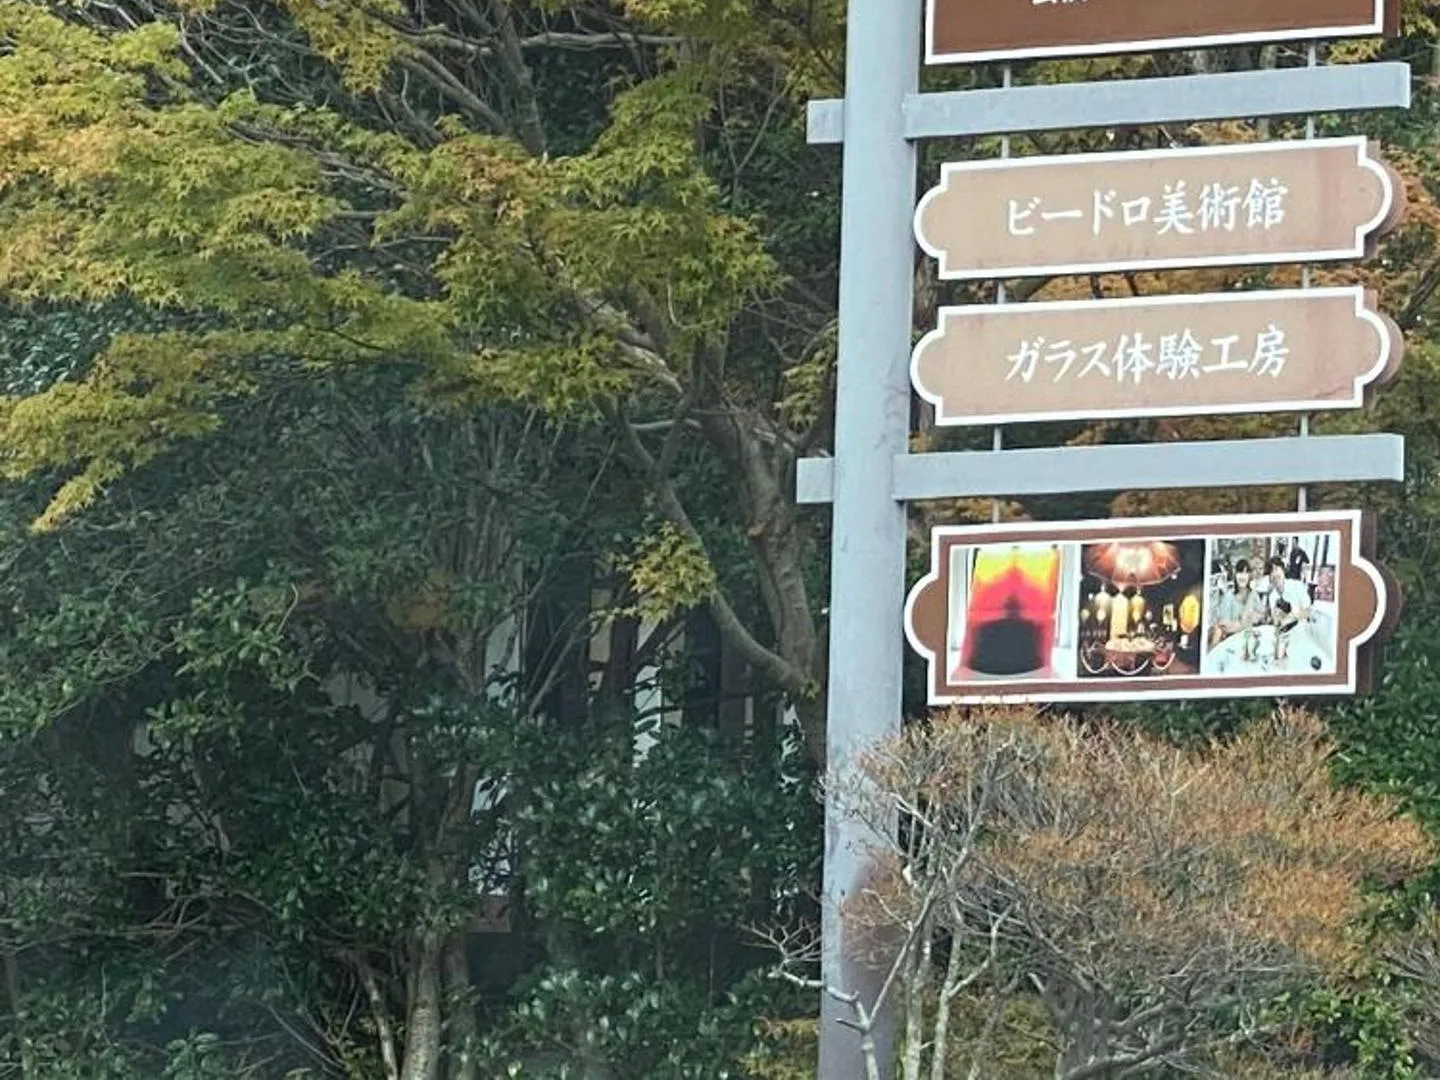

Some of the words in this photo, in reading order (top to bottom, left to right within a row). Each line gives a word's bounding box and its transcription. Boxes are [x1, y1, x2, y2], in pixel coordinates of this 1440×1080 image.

[1007, 177, 1290, 237] ビードロ美術館
[1004, 323, 1290, 384] ガラス体験工房
